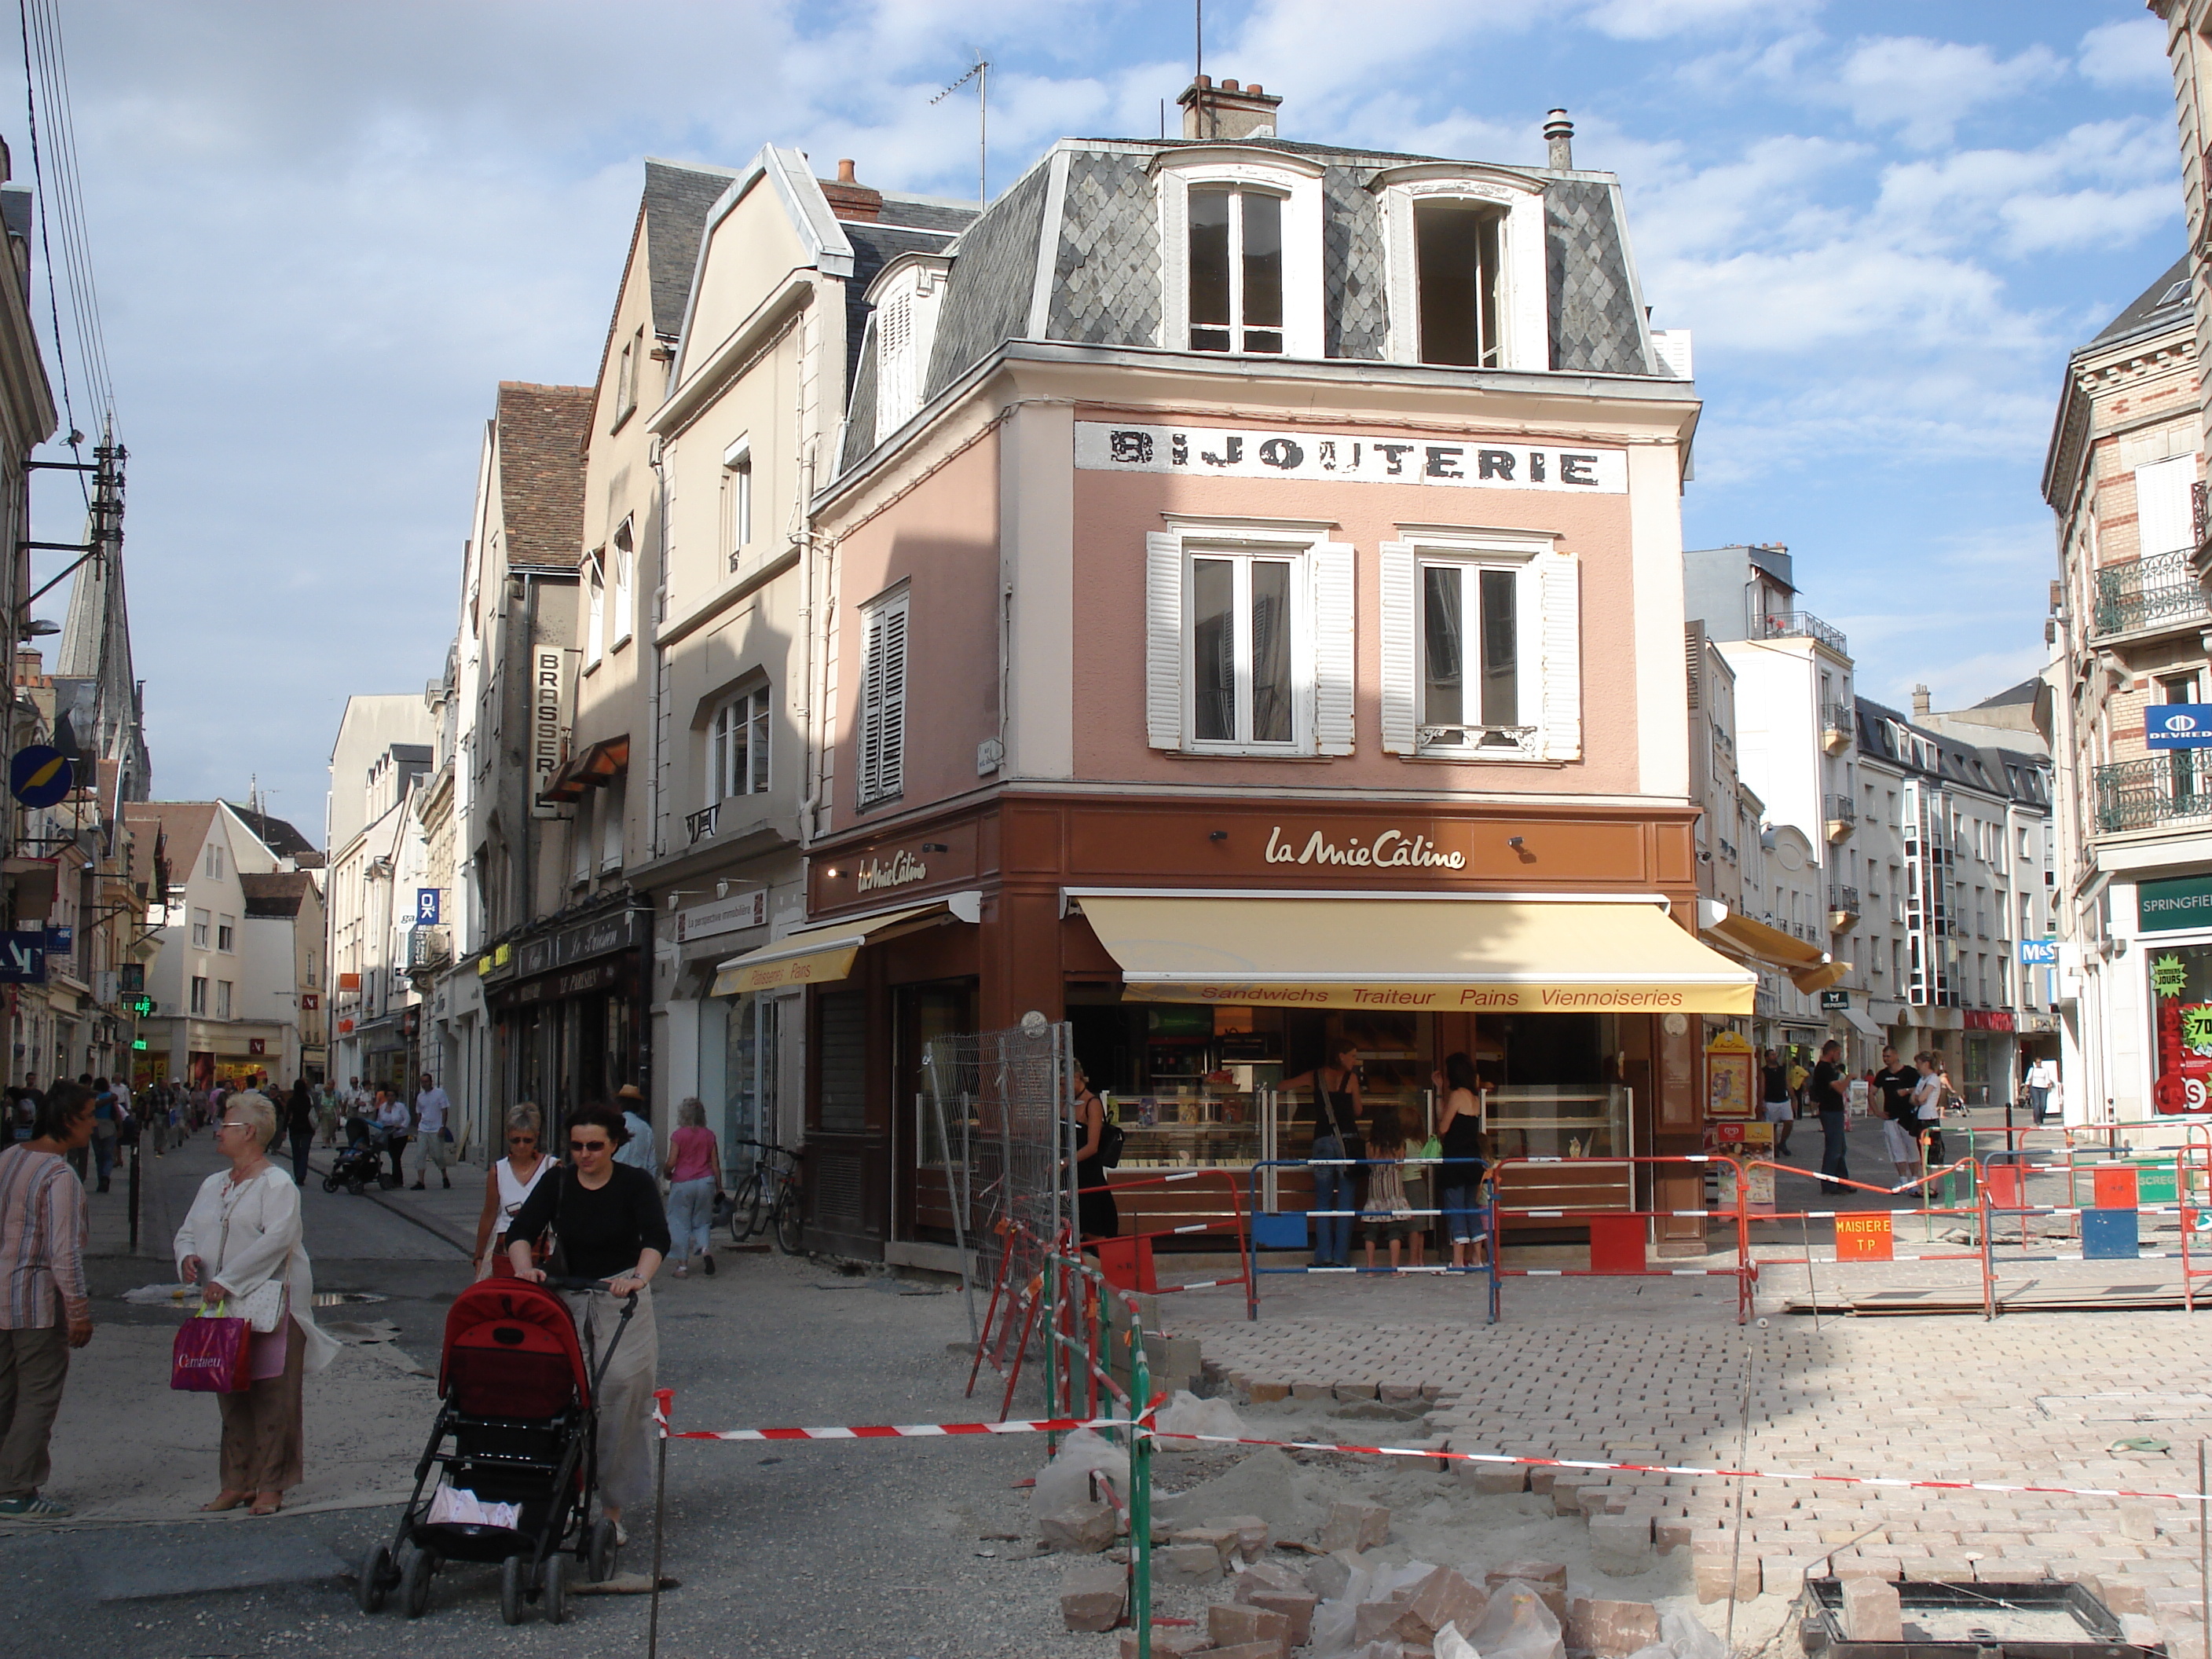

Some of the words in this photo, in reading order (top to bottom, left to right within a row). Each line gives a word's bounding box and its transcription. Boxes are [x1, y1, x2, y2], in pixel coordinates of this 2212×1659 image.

[1111, 430, 1599, 485] BIJOUTERIE
[2149, 731, 2212, 739] DEVRED
[1297, 830, 1372, 866] Mie
[1372, 830, 1466, 870] Câline
[694, 913, 721, 928] perspective
[2023, 943, 2055, 961] M&S
[790, 962, 811, 980] Pains
[2159, 975, 2181, 984] JOURS
[1201, 987, 1329, 1002] Sandwichs
[1352, 988, 1436, 1005] Traiteur
[1459, 989, 1519, 1006] Pains
[1541, 989, 1683, 1006] Viennoiseries
[2139, 1176, 2174, 1185] SCREG
[1837, 1220, 1891, 1232] MAISIERE
